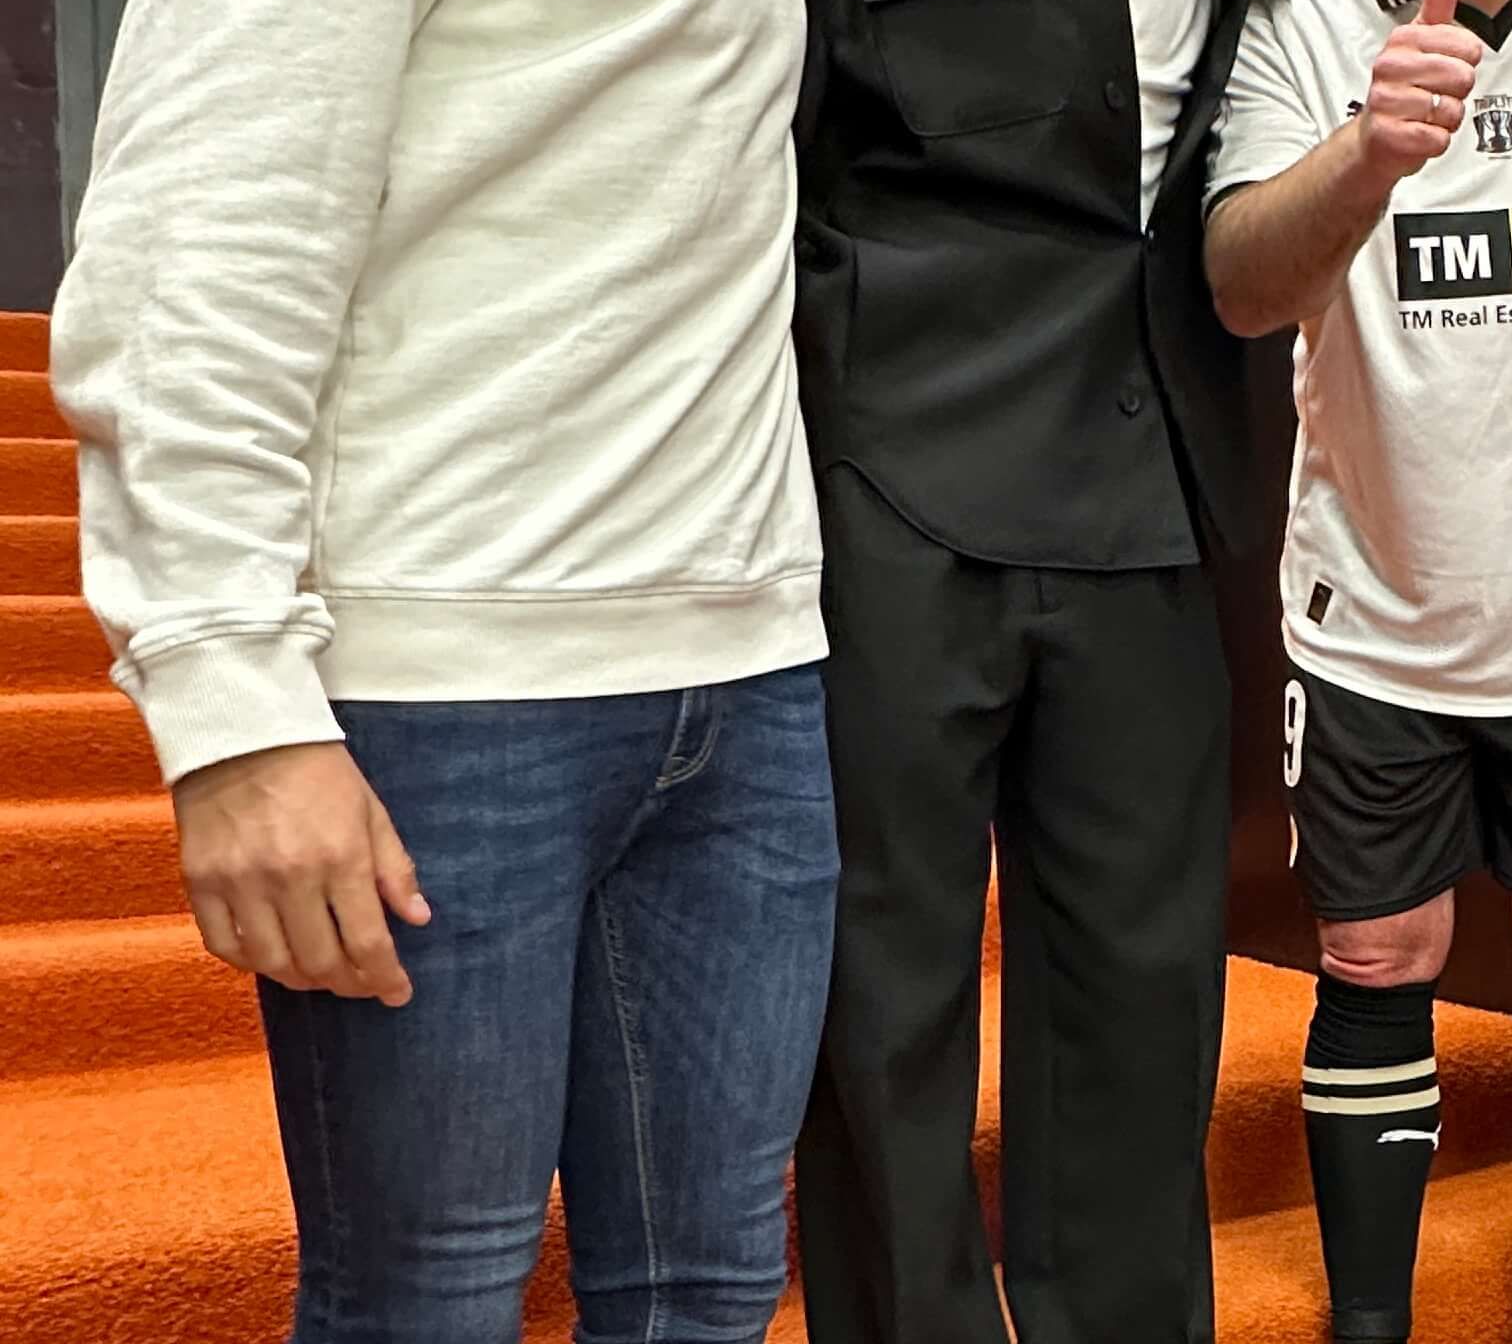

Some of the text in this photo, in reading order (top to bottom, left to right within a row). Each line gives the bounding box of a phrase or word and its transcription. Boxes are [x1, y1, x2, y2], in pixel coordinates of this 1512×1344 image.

[1409, 233, 1493, 283] TM
[1399, 310, 1432, 330] TM
[1441, 305, 1488, 328] Real
[1284, 679, 1307, 788] 9
